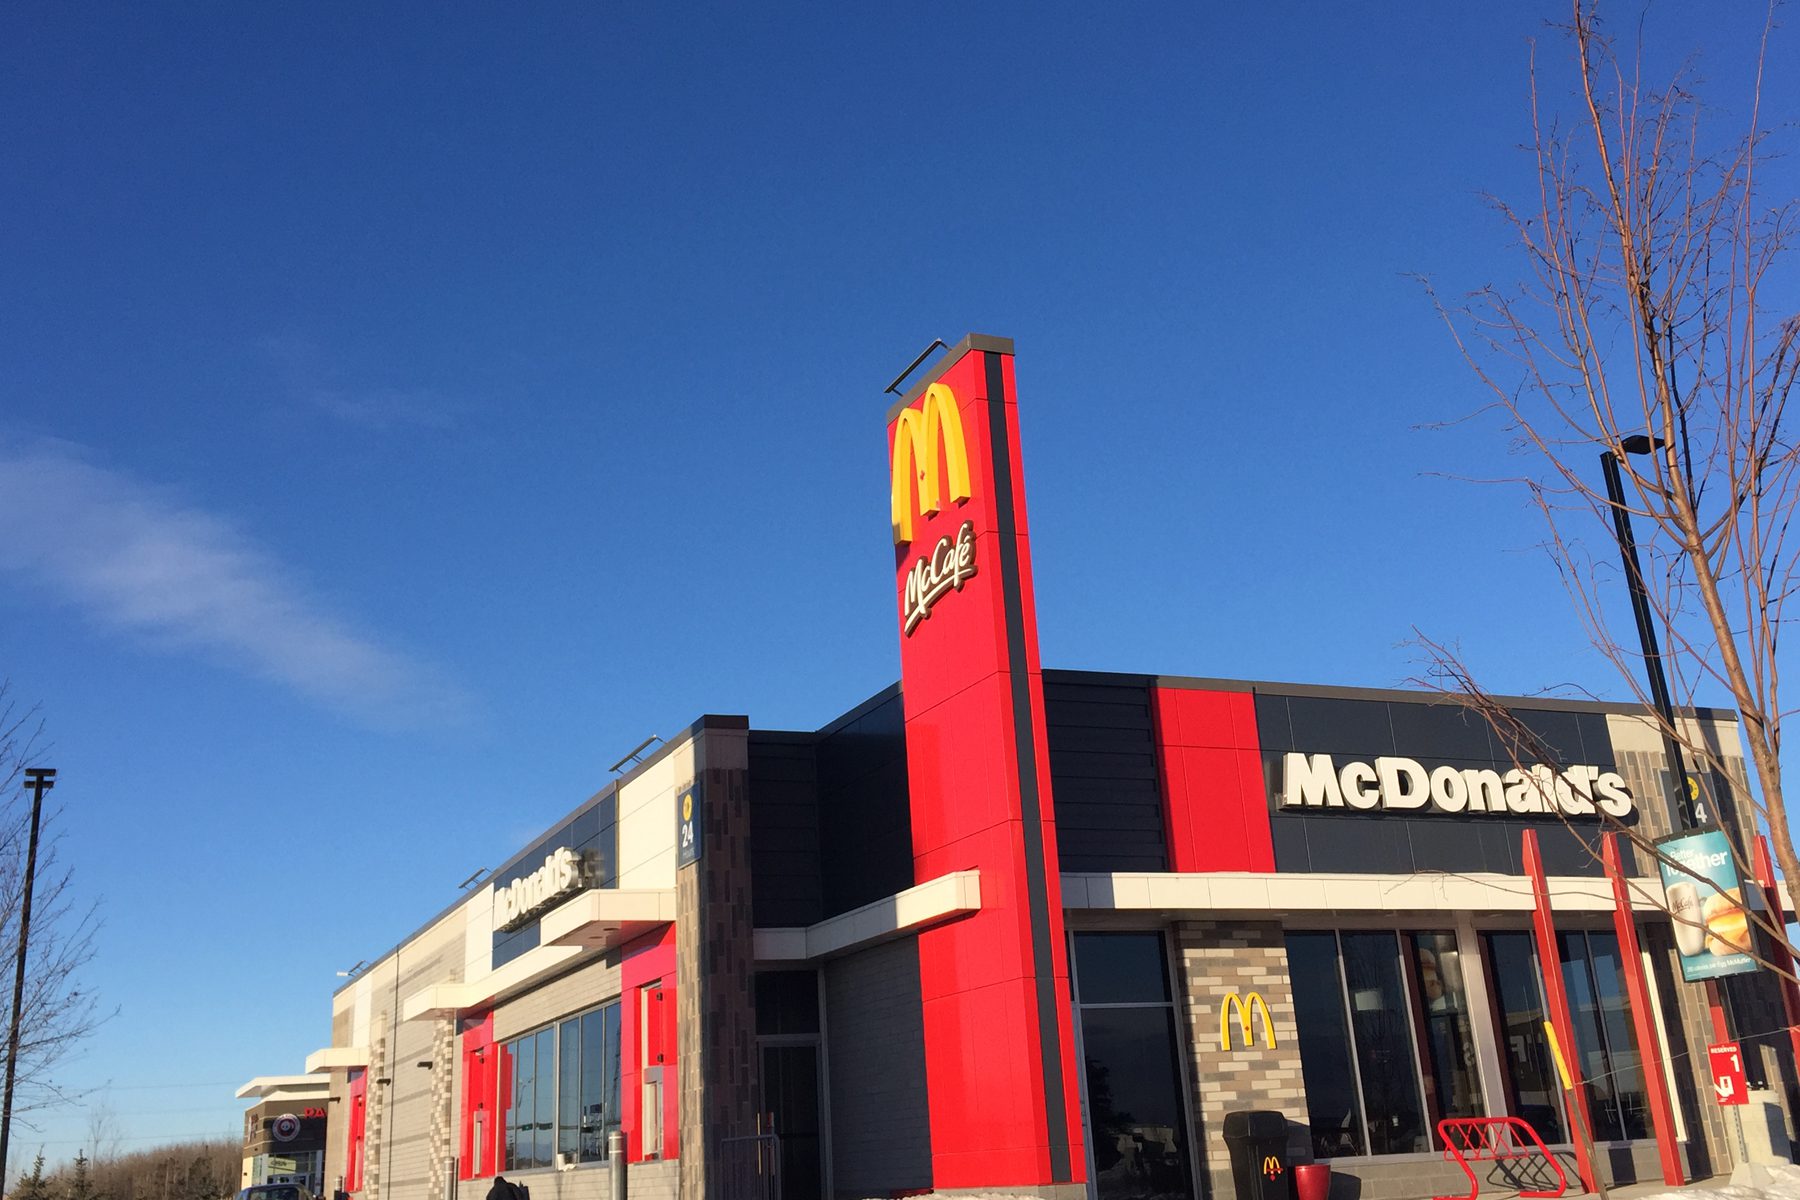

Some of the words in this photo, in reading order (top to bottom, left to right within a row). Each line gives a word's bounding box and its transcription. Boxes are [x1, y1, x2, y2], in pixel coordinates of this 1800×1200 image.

[904, 522, 974, 632] McCafé
[1282, 752, 1632, 818] McDonald's
[682, 820, 694, 848] 24
[1710, 1046, 1737, 1054] RESERVED
[1730, 1054, 1740, 1072] 1
